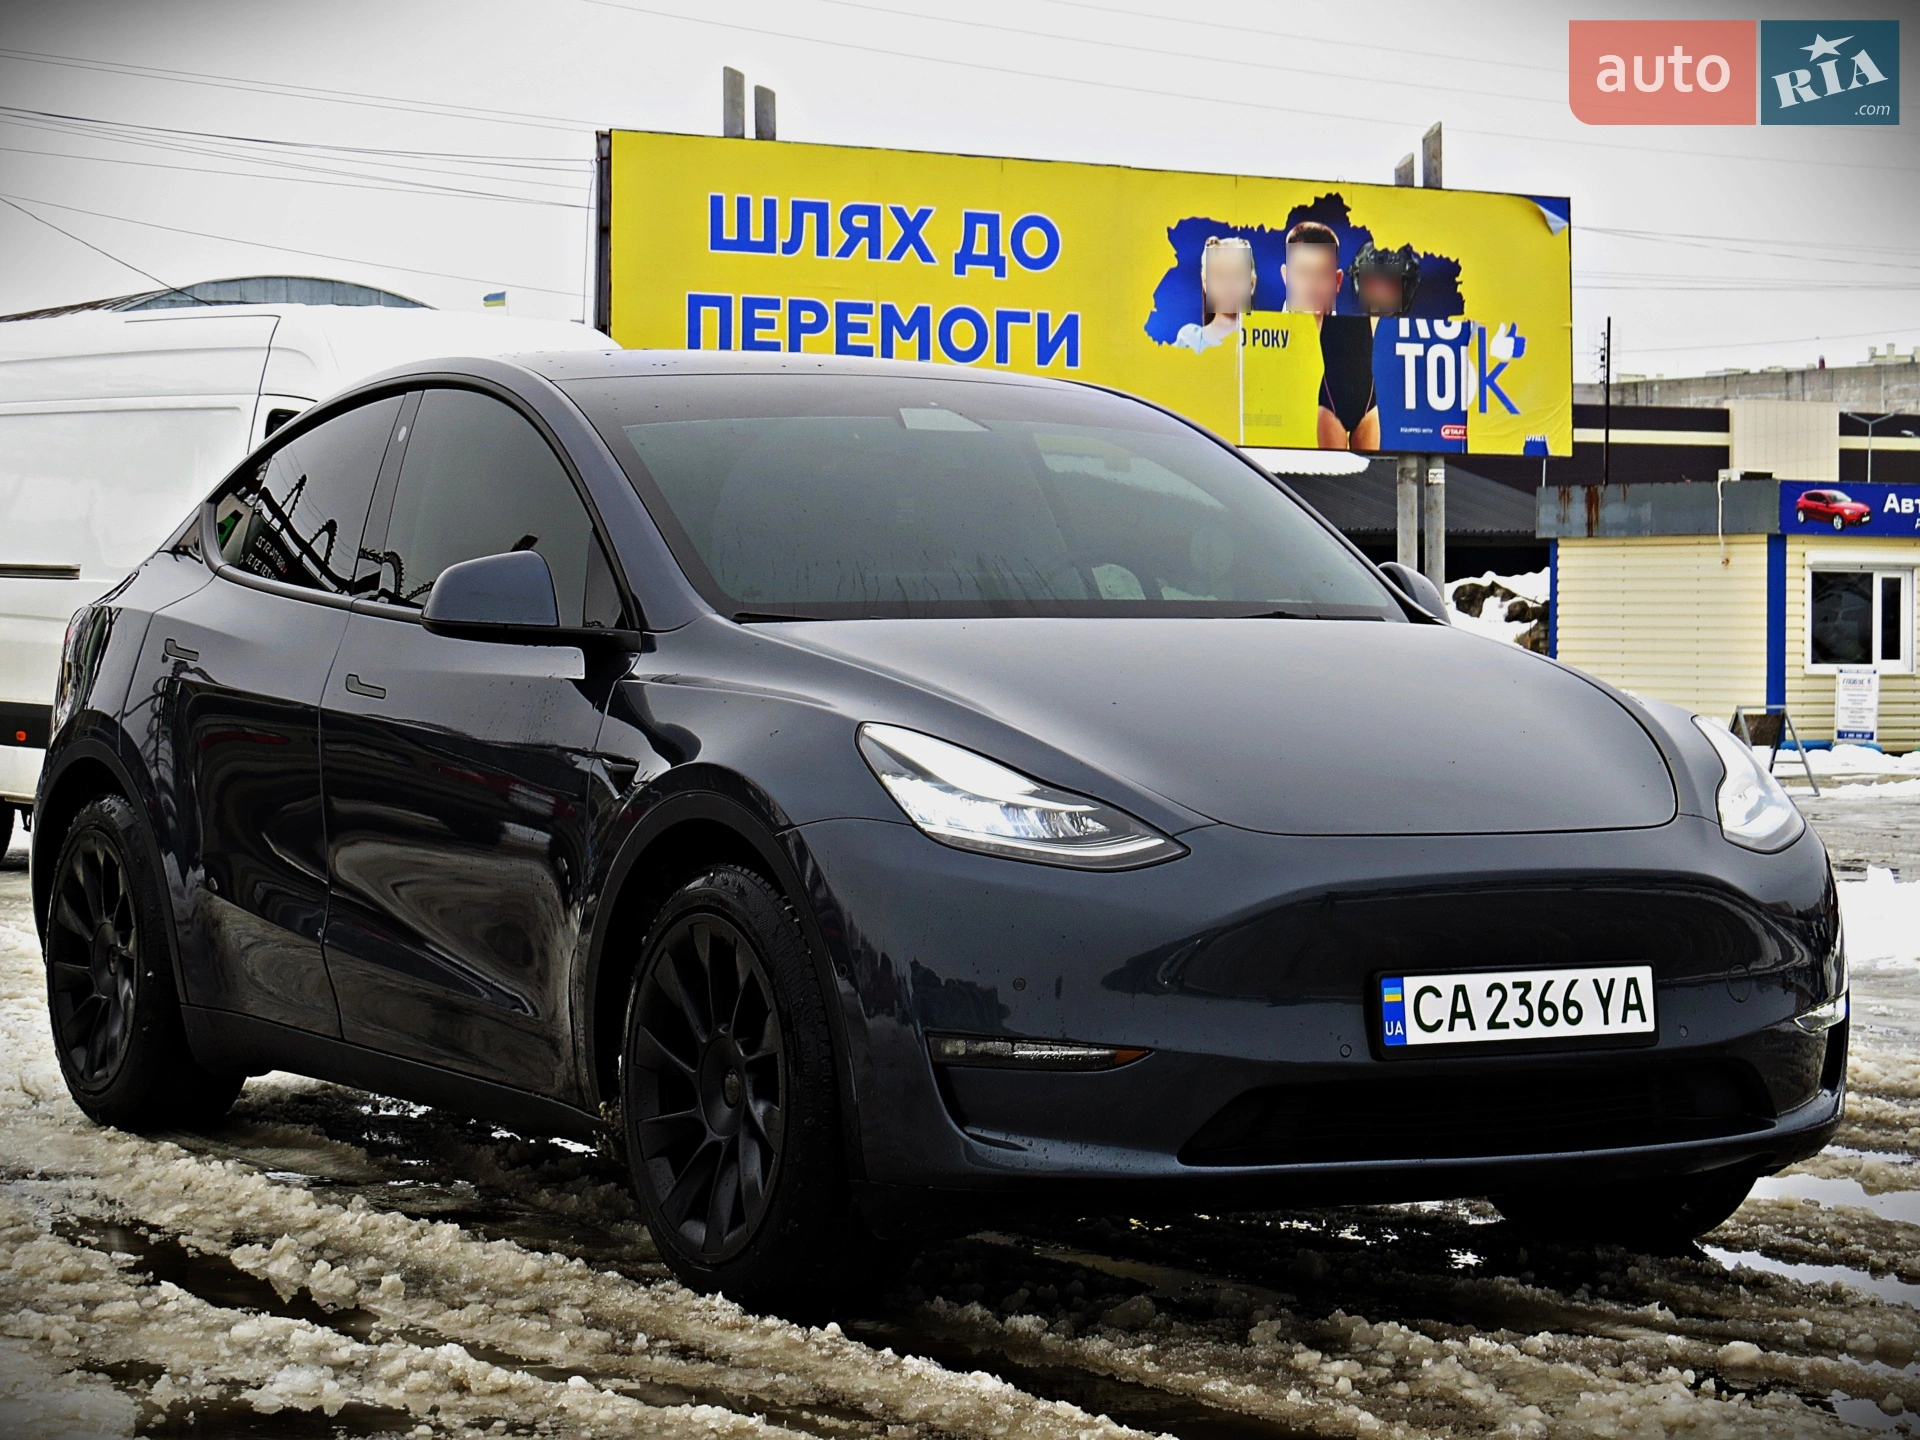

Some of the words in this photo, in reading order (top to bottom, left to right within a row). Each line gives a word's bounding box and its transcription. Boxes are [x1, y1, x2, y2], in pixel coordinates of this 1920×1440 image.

[709, 192, 938, 264] ШЛЯХ
[953, 208, 1061, 280] ДО
[686, 293, 1081, 369] ПЕРЕМОГИ
[1252, 328, 1289, 349] РОКУ
[1385, 1020, 1404, 1036] UA
[1413, 983, 1477, 1033] CA
[1486, 978, 1584, 1031] 2366
[1592, 976, 1647, 1026] YA
